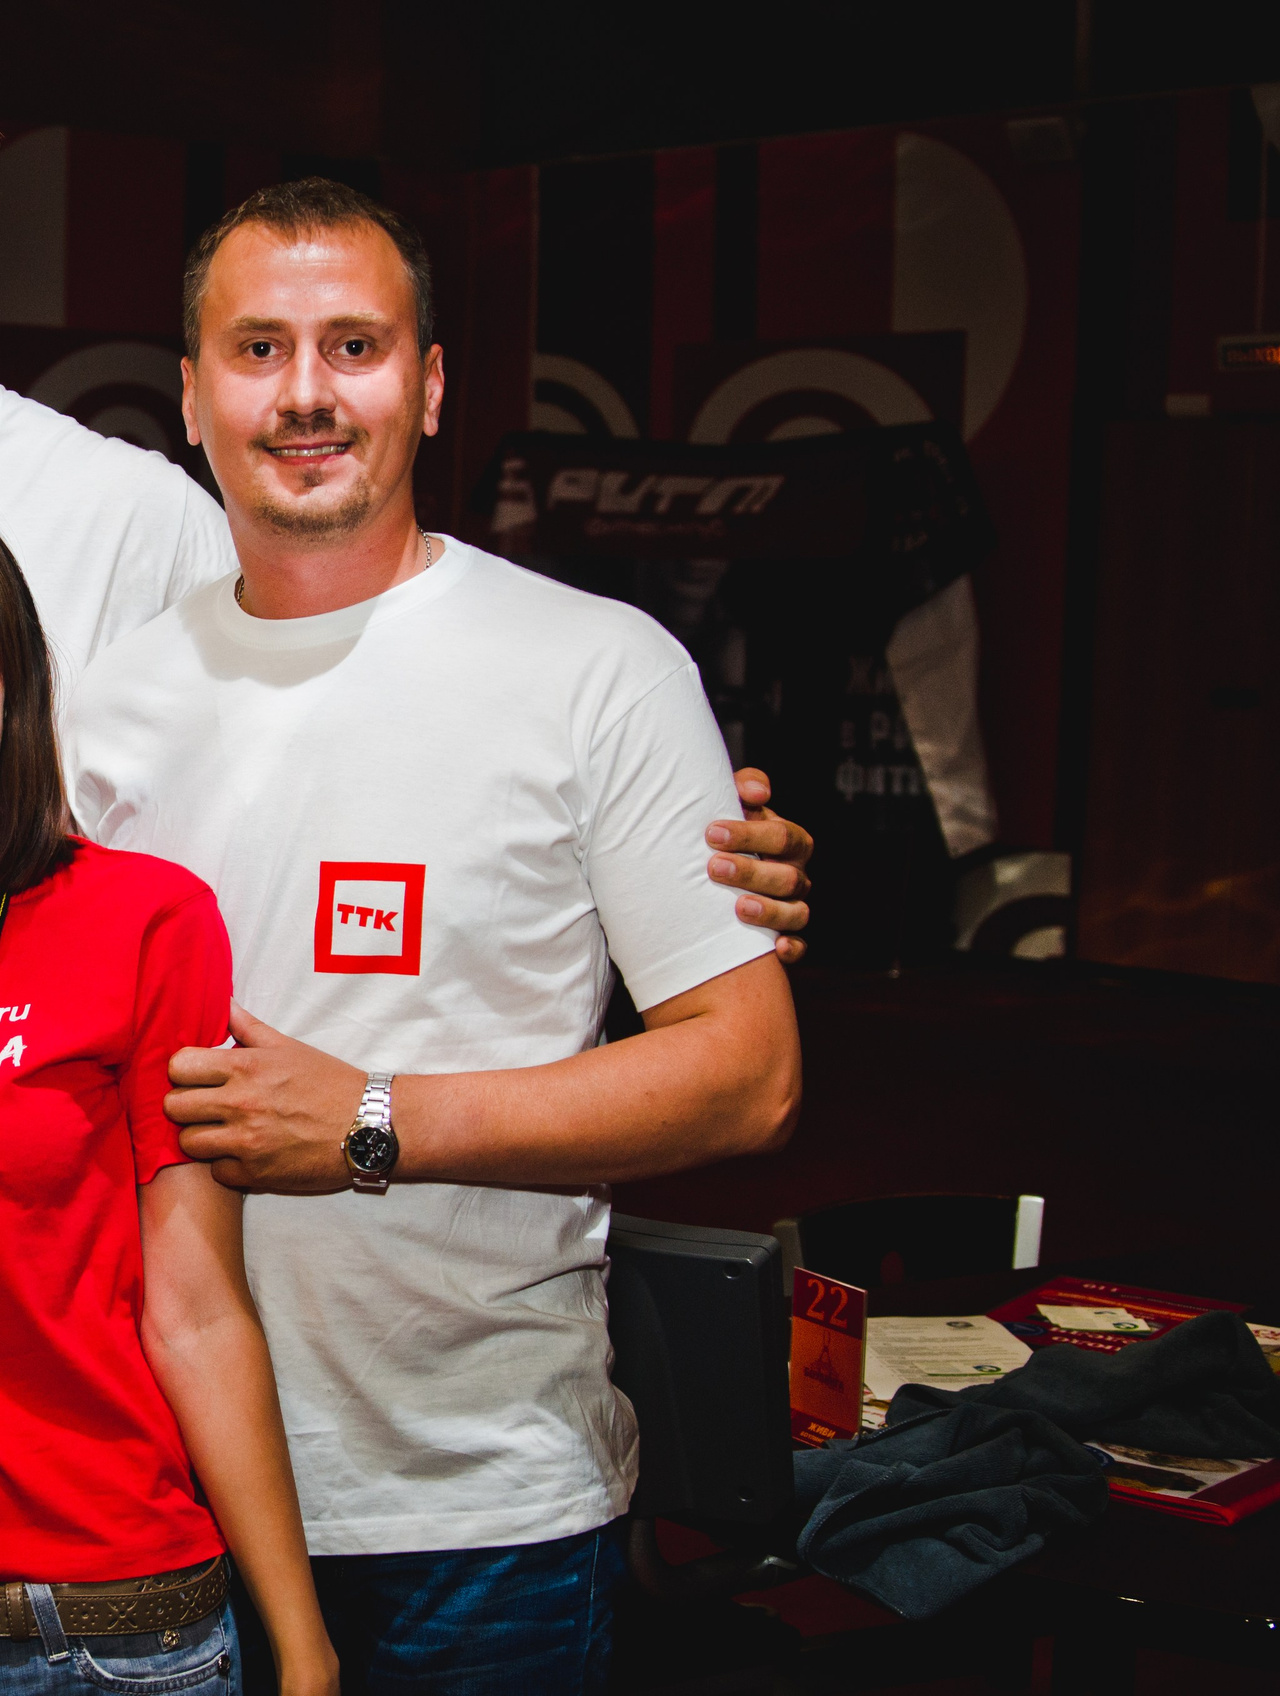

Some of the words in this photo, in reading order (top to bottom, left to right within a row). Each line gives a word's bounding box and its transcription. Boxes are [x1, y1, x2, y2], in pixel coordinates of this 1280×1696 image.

[336, 903, 399, 932] ТТК
[806, 1278, 849, 1329] 22
[807, 1422, 837, 1439] ЖИВИ
